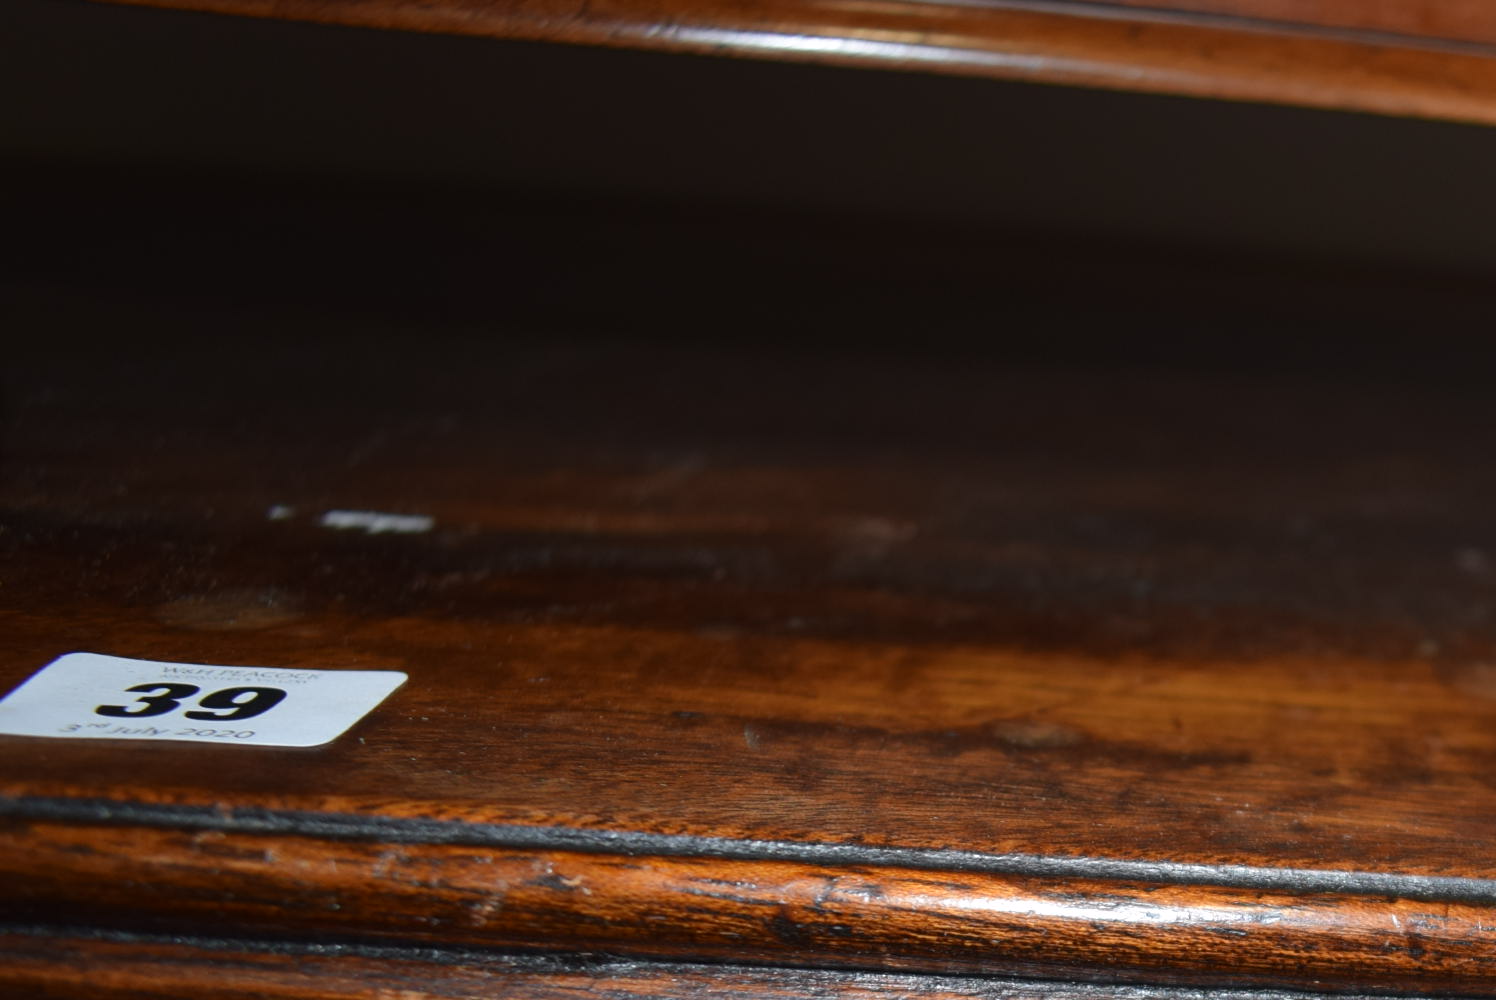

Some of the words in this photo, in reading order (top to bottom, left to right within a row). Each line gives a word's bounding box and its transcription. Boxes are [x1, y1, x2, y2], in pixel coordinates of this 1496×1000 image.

[218, 669, 319, 680] PEACOCK
[94, 682, 288, 721] 39
[104, 726, 170, 737] July
[174, 728, 256, 739] 2020
